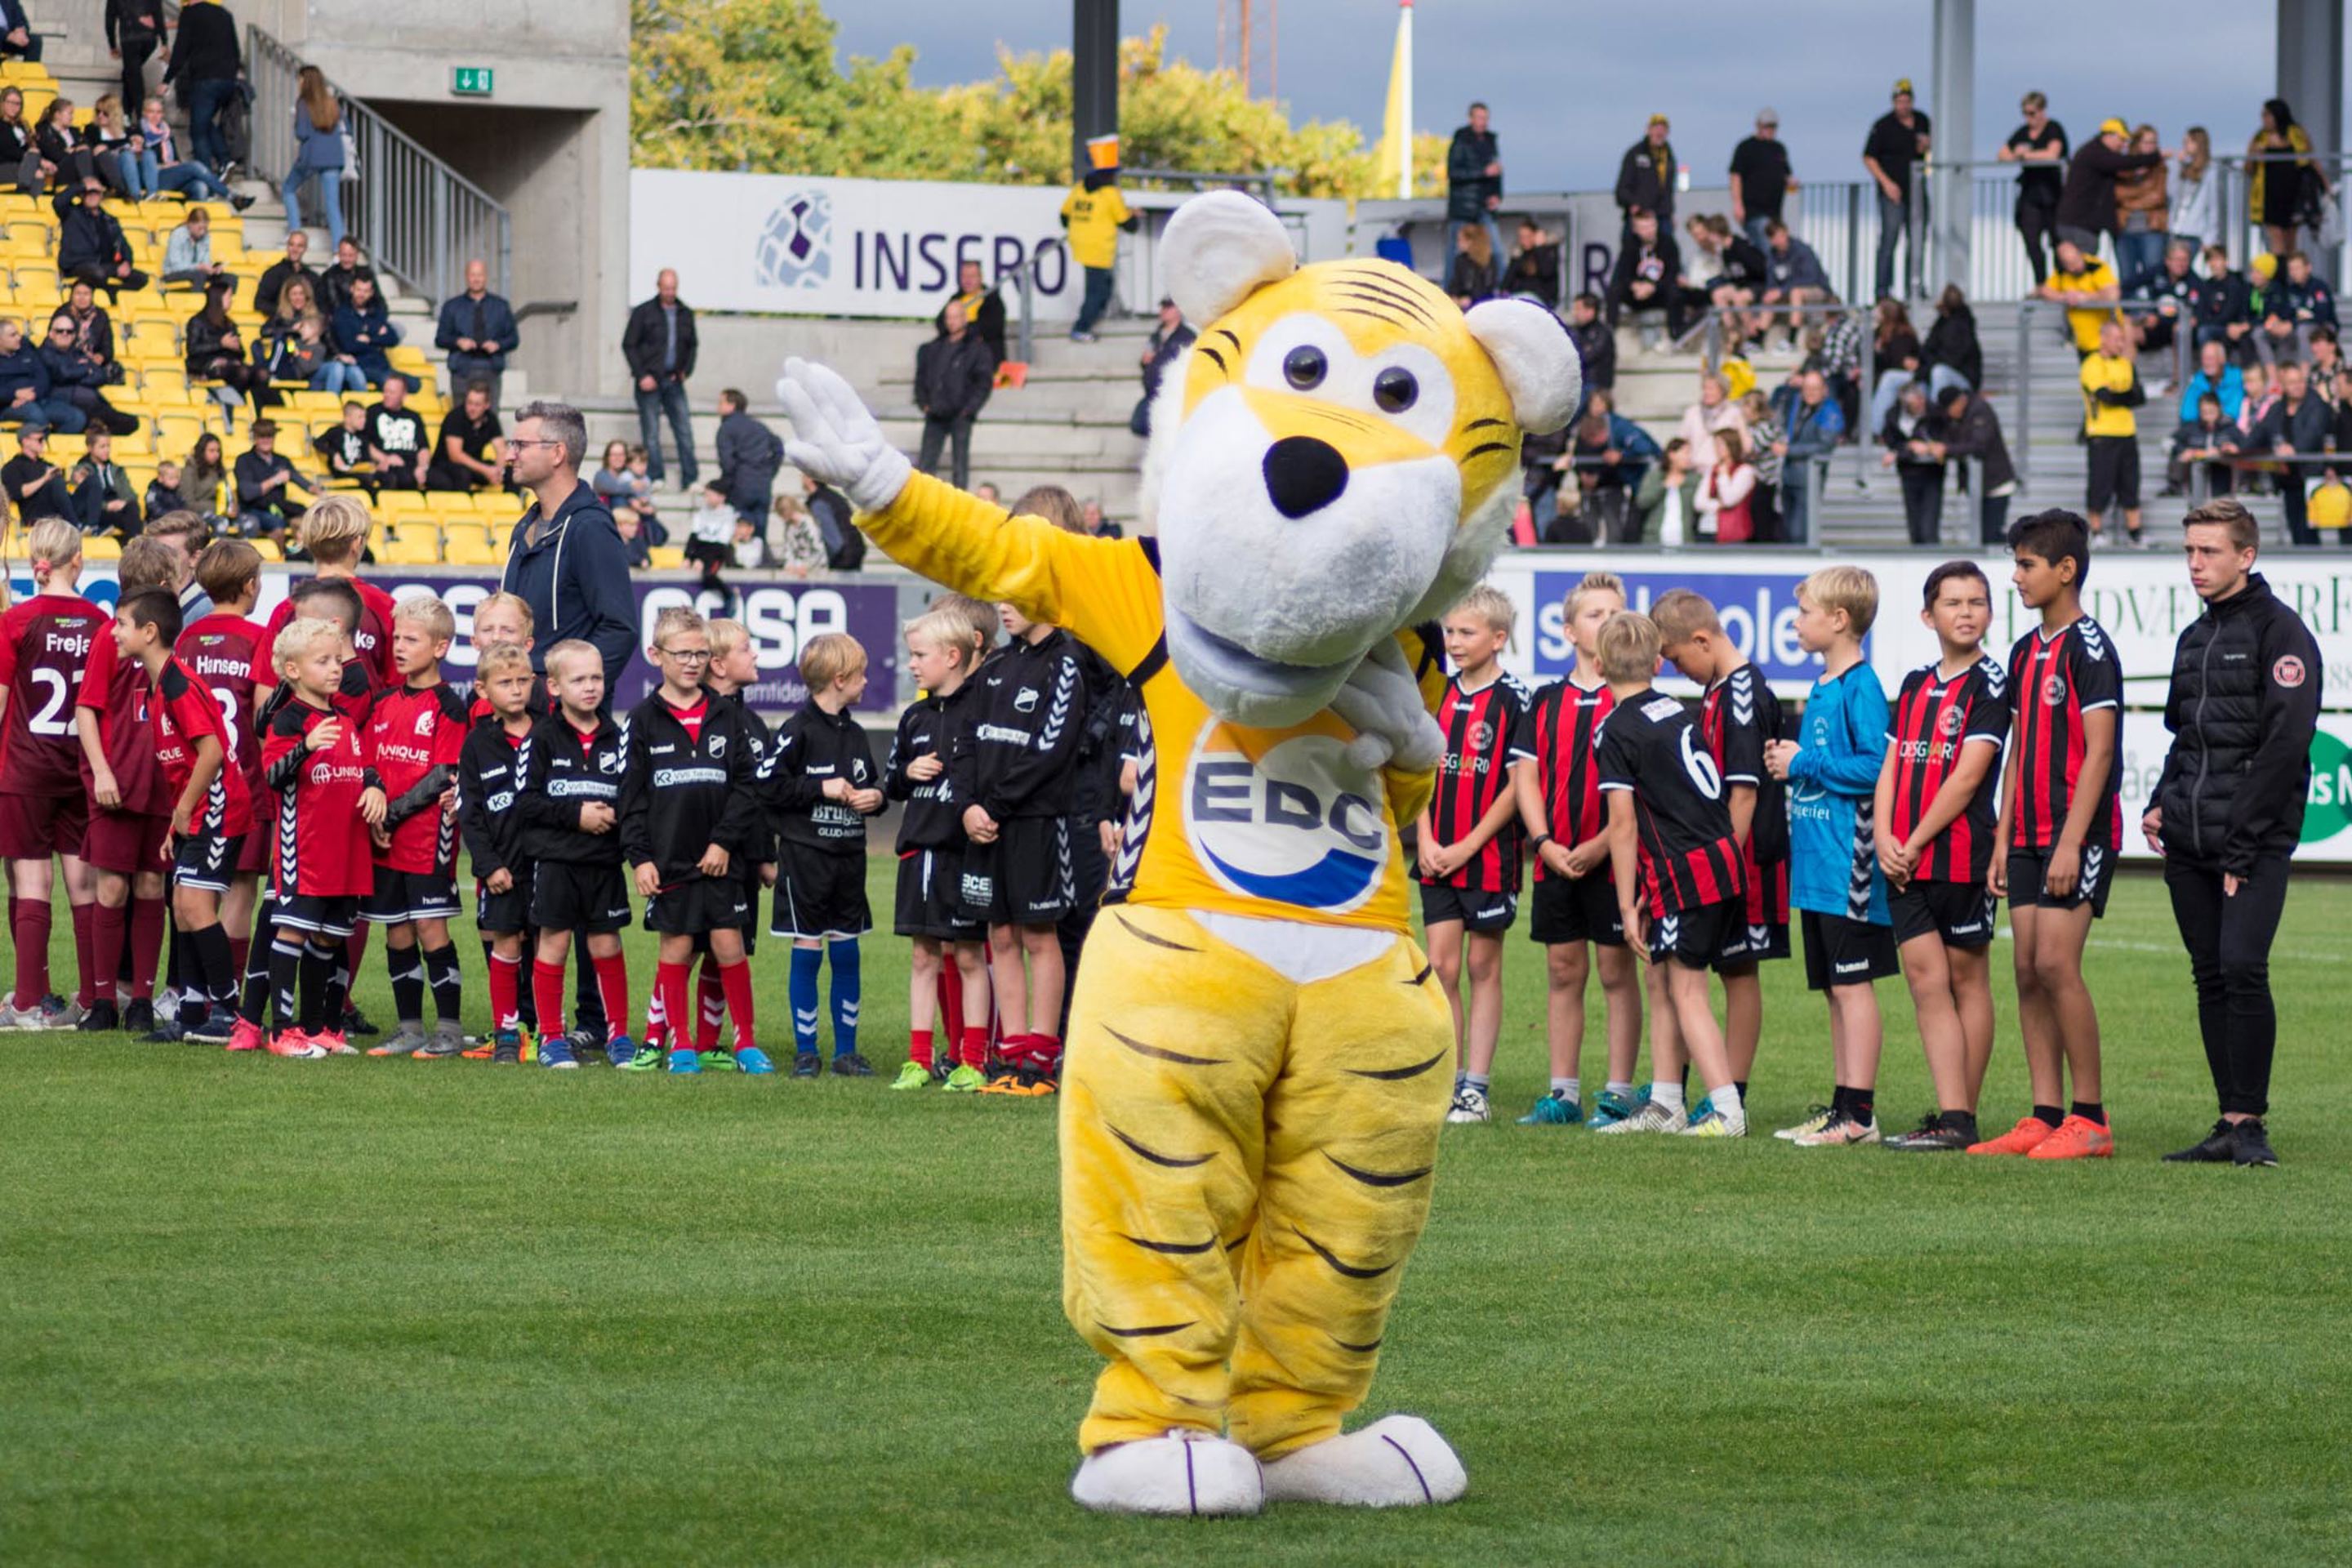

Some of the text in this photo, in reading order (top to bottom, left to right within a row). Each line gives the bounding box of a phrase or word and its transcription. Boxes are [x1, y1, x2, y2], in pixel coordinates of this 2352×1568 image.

[855, 230, 1067, 296] INSERO
[1680, 723, 1722, 800] 6
[1192, 761, 1383, 851] EDC
